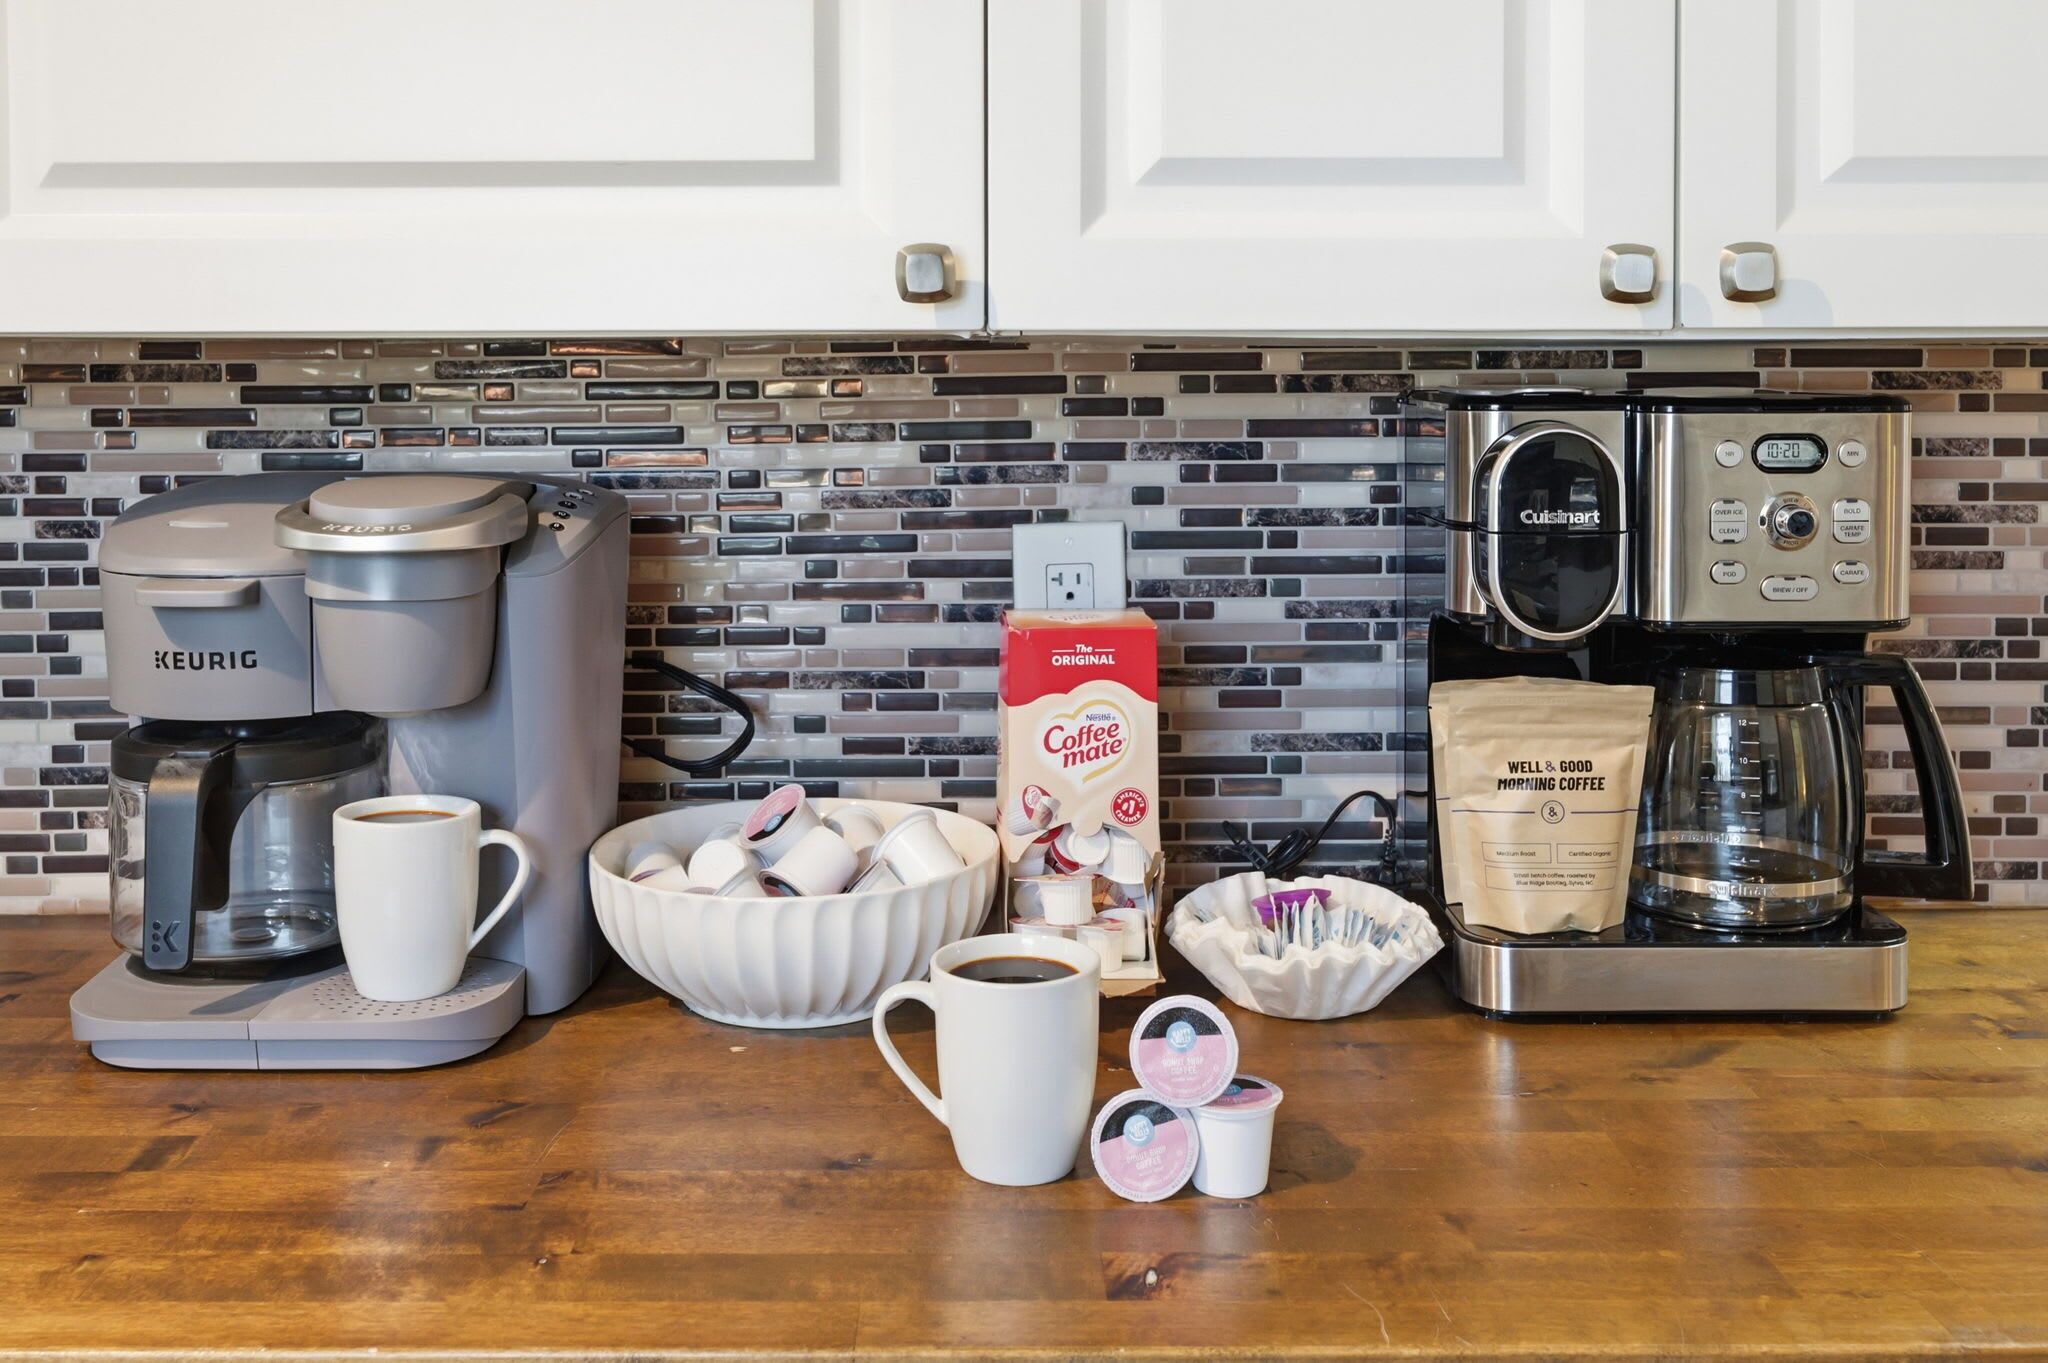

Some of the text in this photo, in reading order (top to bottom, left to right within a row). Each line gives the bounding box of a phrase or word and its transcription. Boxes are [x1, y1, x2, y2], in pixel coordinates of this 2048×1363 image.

[1766, 442, 1800, 459] 10:20
[1846, 450, 1860, 458] MIN
[1714, 508, 1744, 516] OVER ICE
[1843, 507, 1861, 515] BOLD
[1520, 509, 1600, 525] Cuisinart
[1718, 527, 1740, 535] CLEAN
[1839, 525, 1865, 533] CARAFE
[1722, 570, 1737, 578] POD
[1839, 569, 1865, 577] CARAFE
[1772, 586, 1793, 594] BREW
[1796, 586, 1809, 594] OFF
[1075, 643, 1093, 654] The
[154, 650, 259, 671] KEURIG
[1052, 654, 1116, 667] ORIGINAL
[1738, 719, 1747, 727] 12
[1043, 723, 1120, 754] Coffee
[1063, 739, 1123, 768] mate
[1739, 757, 1748, 765] 10
[1507, 760, 1594, 774] WELL & GOOD
[1497, 776, 1606, 791] MORNING COFFEE
[1740, 791, 1747, 799] 8
[1547, 806, 1559, 818] &
[1496, 850, 1537, 858] Medium Roast
[1568, 850, 1612, 859] Certified Organic
[1588, 872, 1596, 880] by
[1529, 879, 1546, 888] Ridge
